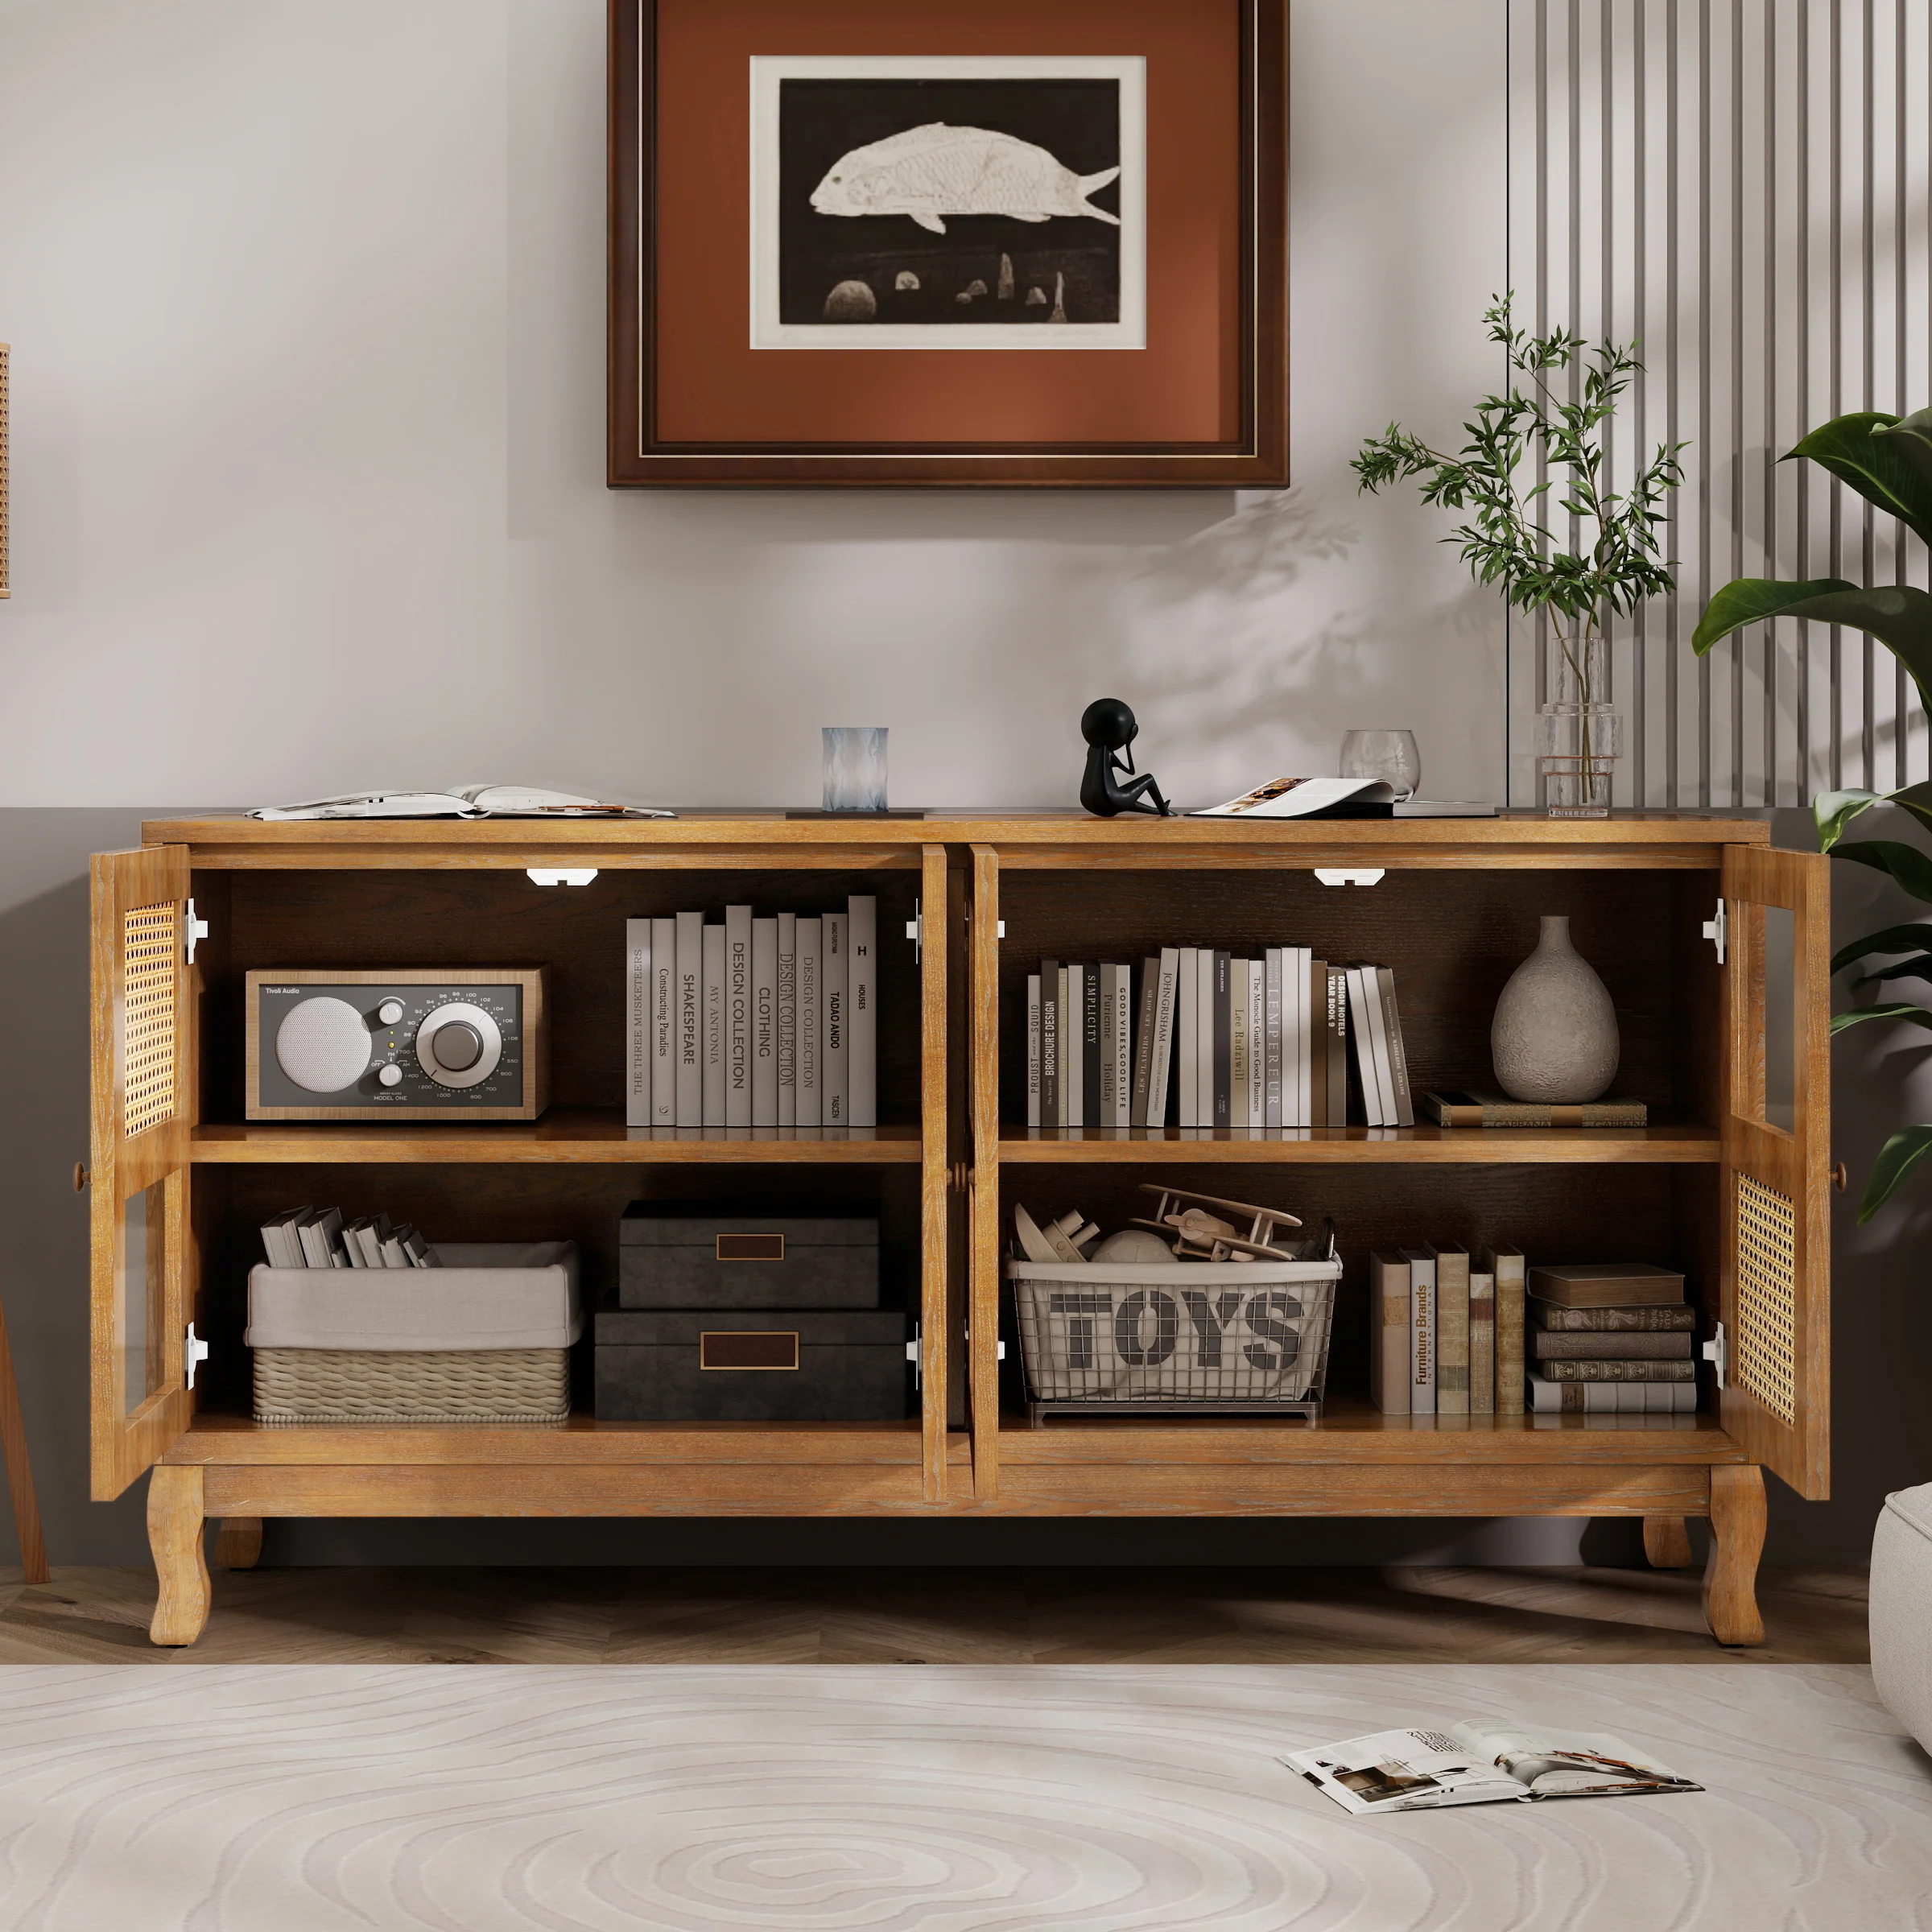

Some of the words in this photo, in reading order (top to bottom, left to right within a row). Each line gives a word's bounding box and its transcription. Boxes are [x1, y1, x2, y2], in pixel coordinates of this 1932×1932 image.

[634, 948, 642, 1026] MUSKETEERS
[733, 942, 745, 995] DESIGN
[780, 953, 794, 1002] DESIGN
[803, 956, 814, 1005] DESIGN
[1338, 975, 1346, 1005] DESIGN
[657, 968, 669, 1021] Constructing
[710, 985, 719, 1005] MY
[830, 991, 840, 1021] TADAO
[858, 984, 866, 1010] HOUSES
[1045, 1001, 1055, 1030] DESIGN
[1087, 975, 1096, 1044] SIMPLICITY
[1104, 994, 1113, 1039] Purienne
[659, 1022, 669, 1057] Paradies
[683, 974, 695, 1065] SHAKESPEARE
[710, 1008, 719, 1065] ANTONIA
[758, 987, 770, 1058] CLOTHING
[830, 1022, 840, 1049] ANDO
[1030, 1004, 1039, 1033] SQUID
[1236, 1009, 1245, 1027] Lee
[1338, 1006, 1346, 1036] HOTELS
[634, 1029, 642, 1068] THREE
[733, 998, 745, 1089] COLLECTION
[780, 1005, 794, 1087] COLLECTION
[803, 1008, 814, 1088] COLLECTION
[1045, 1031, 1055, 1076] BROCHURE
[1140, 1033, 1150, 1075] PLAISIRS
[1236, 1030, 1245, 1081] Radziwill
[1253, 1050, 1261, 1058] to
[1268, 989, 1279, 1105] LEMPEREUR
[634, 1071, 642, 1095] THE
[1030, 1057, 1039, 1093] PROUST
[1102, 1063, 1113, 1103] Holiday
[1050, 1290, 1304, 1369] TOYS
[1415, 1285, 1426, 1332] Brands
[1415, 1336, 1426, 1385] Furniture
